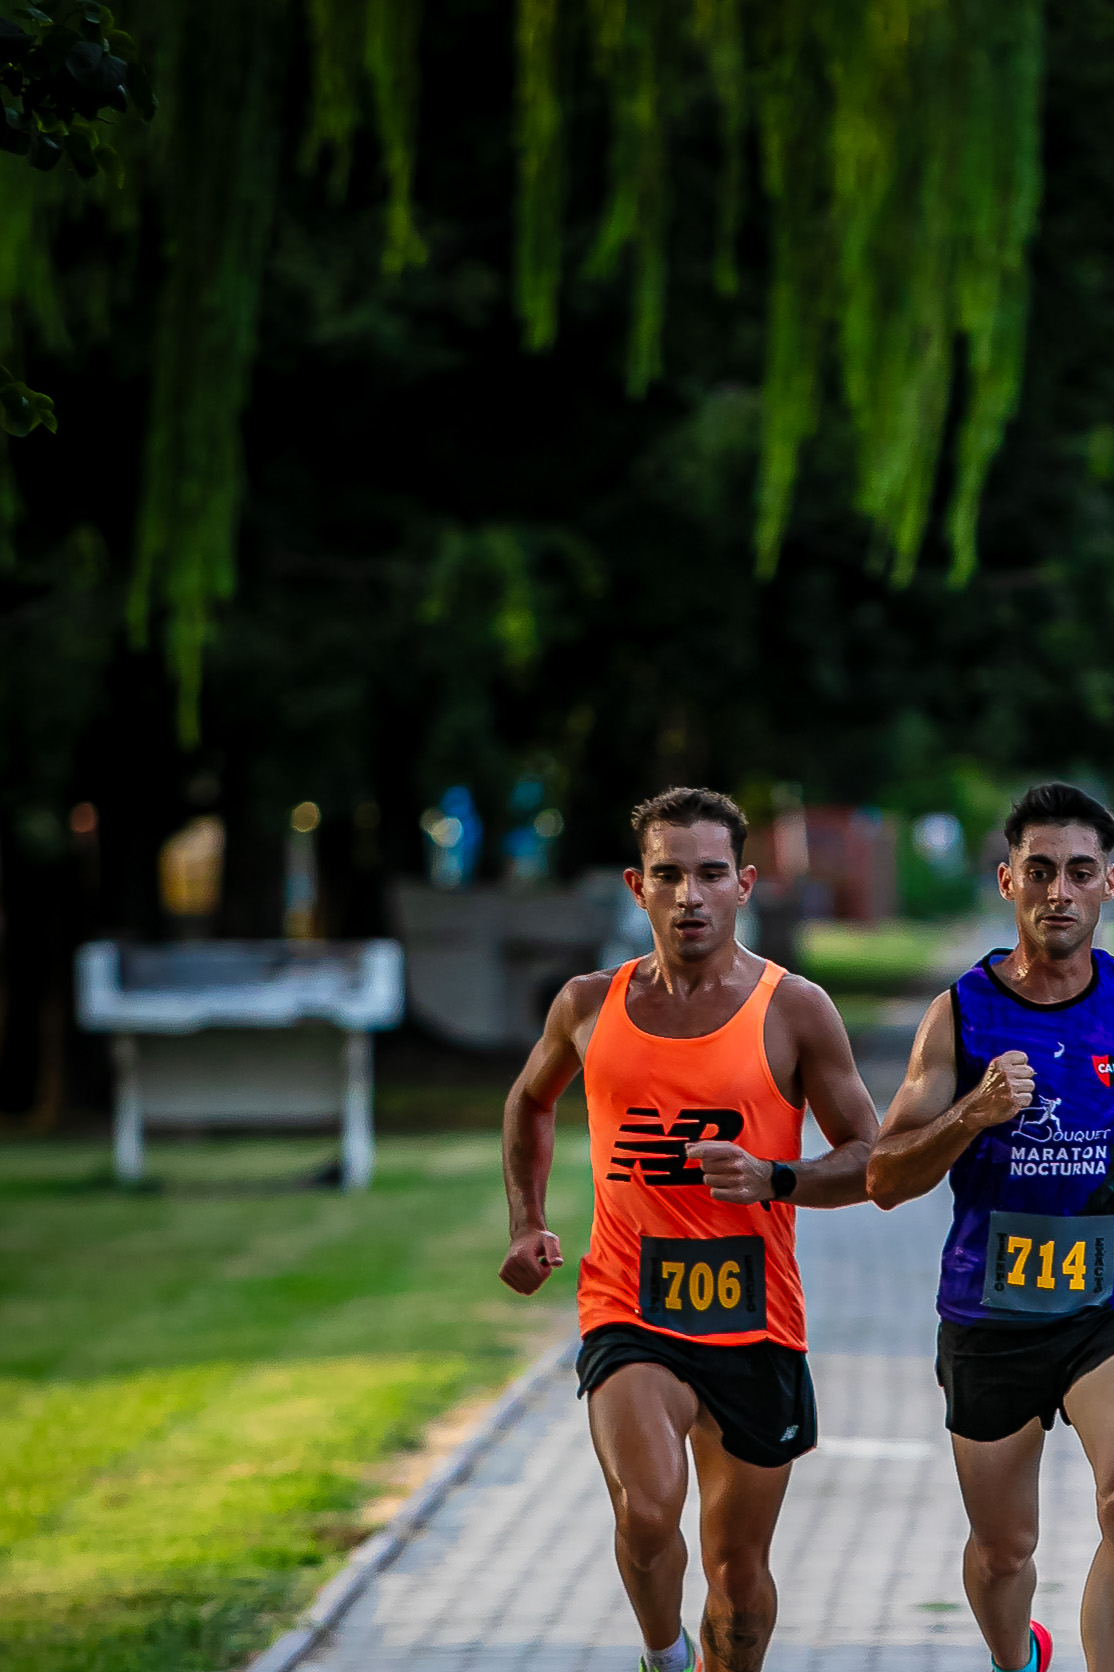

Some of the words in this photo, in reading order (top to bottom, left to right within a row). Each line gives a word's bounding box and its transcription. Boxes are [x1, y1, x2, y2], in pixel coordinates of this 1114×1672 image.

[1010, 1161, 1107, 1176] NOCTURNA
[1011, 1146, 1107, 1161] MARATON
[1007, 1235, 1086, 1290] 714
[661, 1260, 741, 1311] 706
